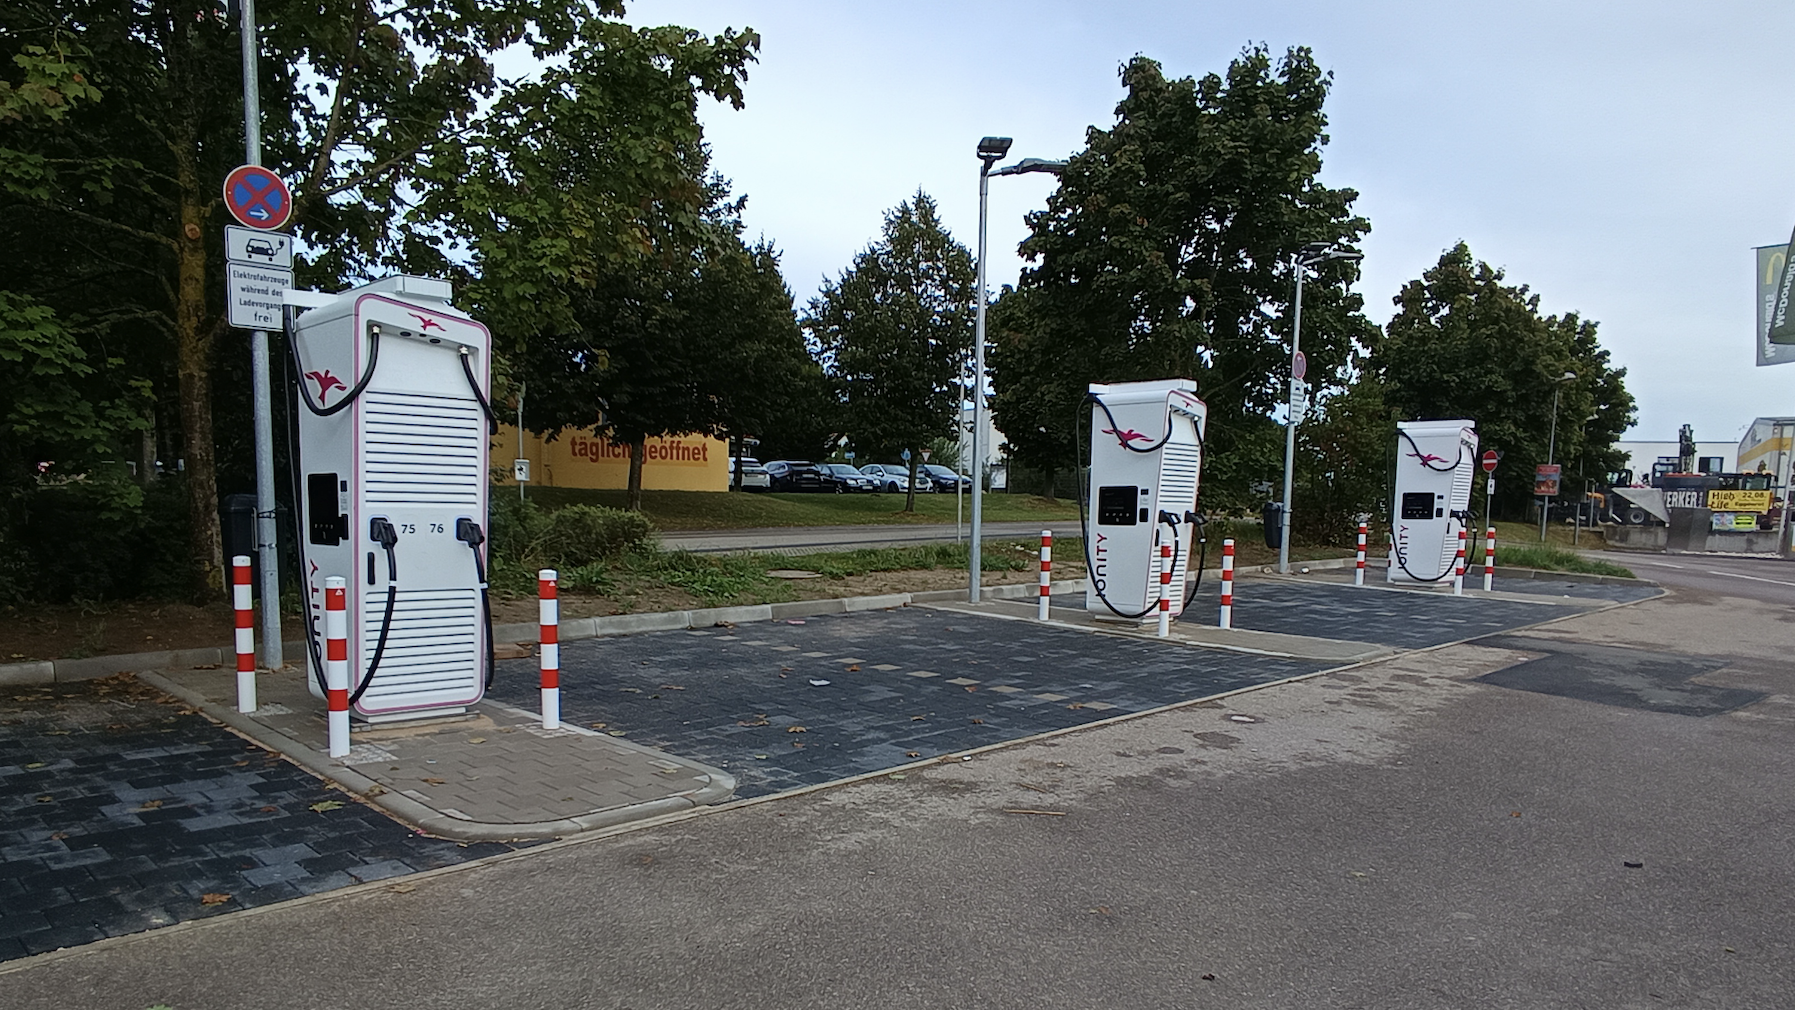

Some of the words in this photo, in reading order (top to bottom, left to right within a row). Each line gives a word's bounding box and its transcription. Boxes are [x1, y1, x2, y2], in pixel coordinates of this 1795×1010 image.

[233, 270, 288, 286] Elektrofahrzeuge
[240, 285, 268, 295] während
[240, 298, 281, 311] Ladevorgang
[254, 312, 272, 322] frei
[570, 436, 632, 463] täglich
[1665, 491, 1698, 508] ERKER
[401, 524, 416, 534] 75
[429, 523, 444, 534] 76
[1398, 525, 1408, 568] IONITY
[1096, 533, 1107, 596] IONITY
[310, 558, 322, 663] ONITY
